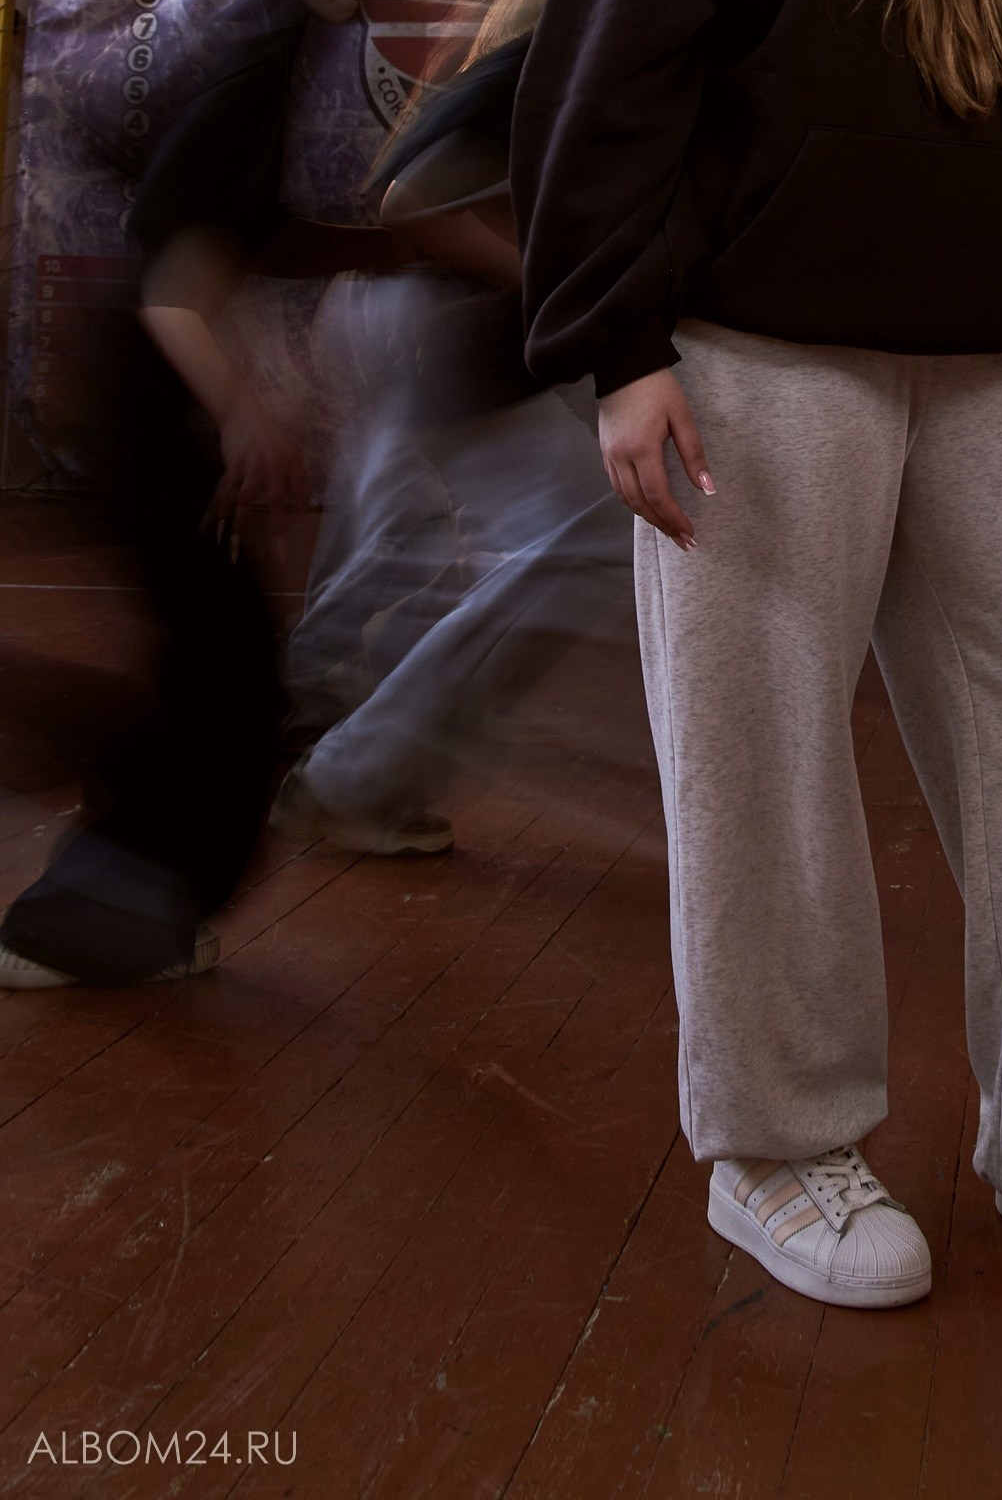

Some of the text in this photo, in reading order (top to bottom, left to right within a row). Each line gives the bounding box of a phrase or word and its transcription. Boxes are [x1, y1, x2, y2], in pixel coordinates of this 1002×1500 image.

[139, 17, 153, 38] 7
[132, 48, 148, 69] 6
[129, 80, 144, 100] 5
[126, 112, 143, 133] 4
[44, 259, 60, 273] 10
[42, 285, 54, 298] 9
